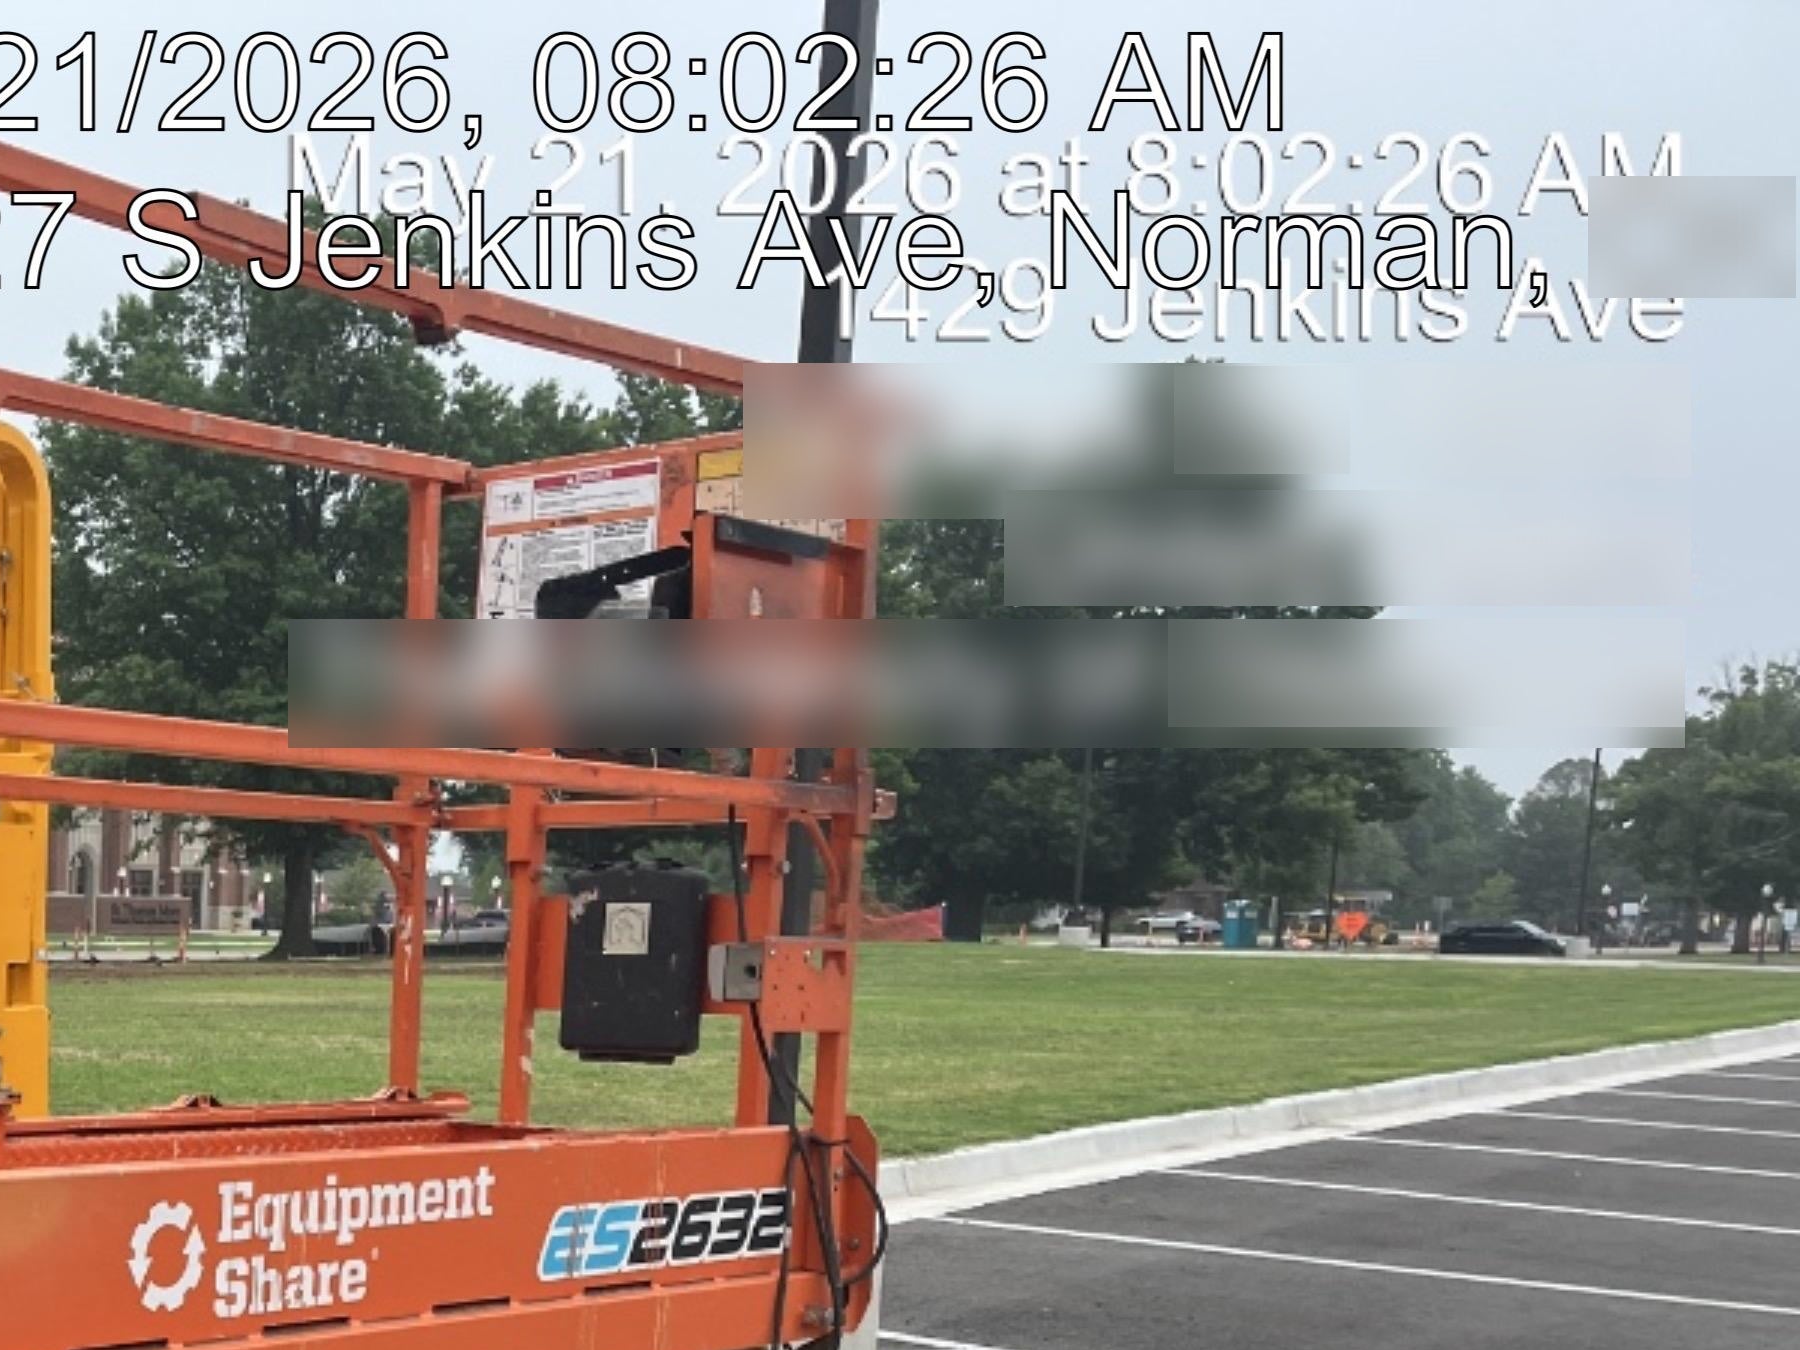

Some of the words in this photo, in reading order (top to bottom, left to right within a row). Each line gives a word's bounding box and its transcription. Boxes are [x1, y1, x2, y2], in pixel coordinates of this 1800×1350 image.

[215, 1165, 496, 1251] Equipment
[538, 1187, 792, 1282] ES2632
[213, 1252, 369, 1319] Share
